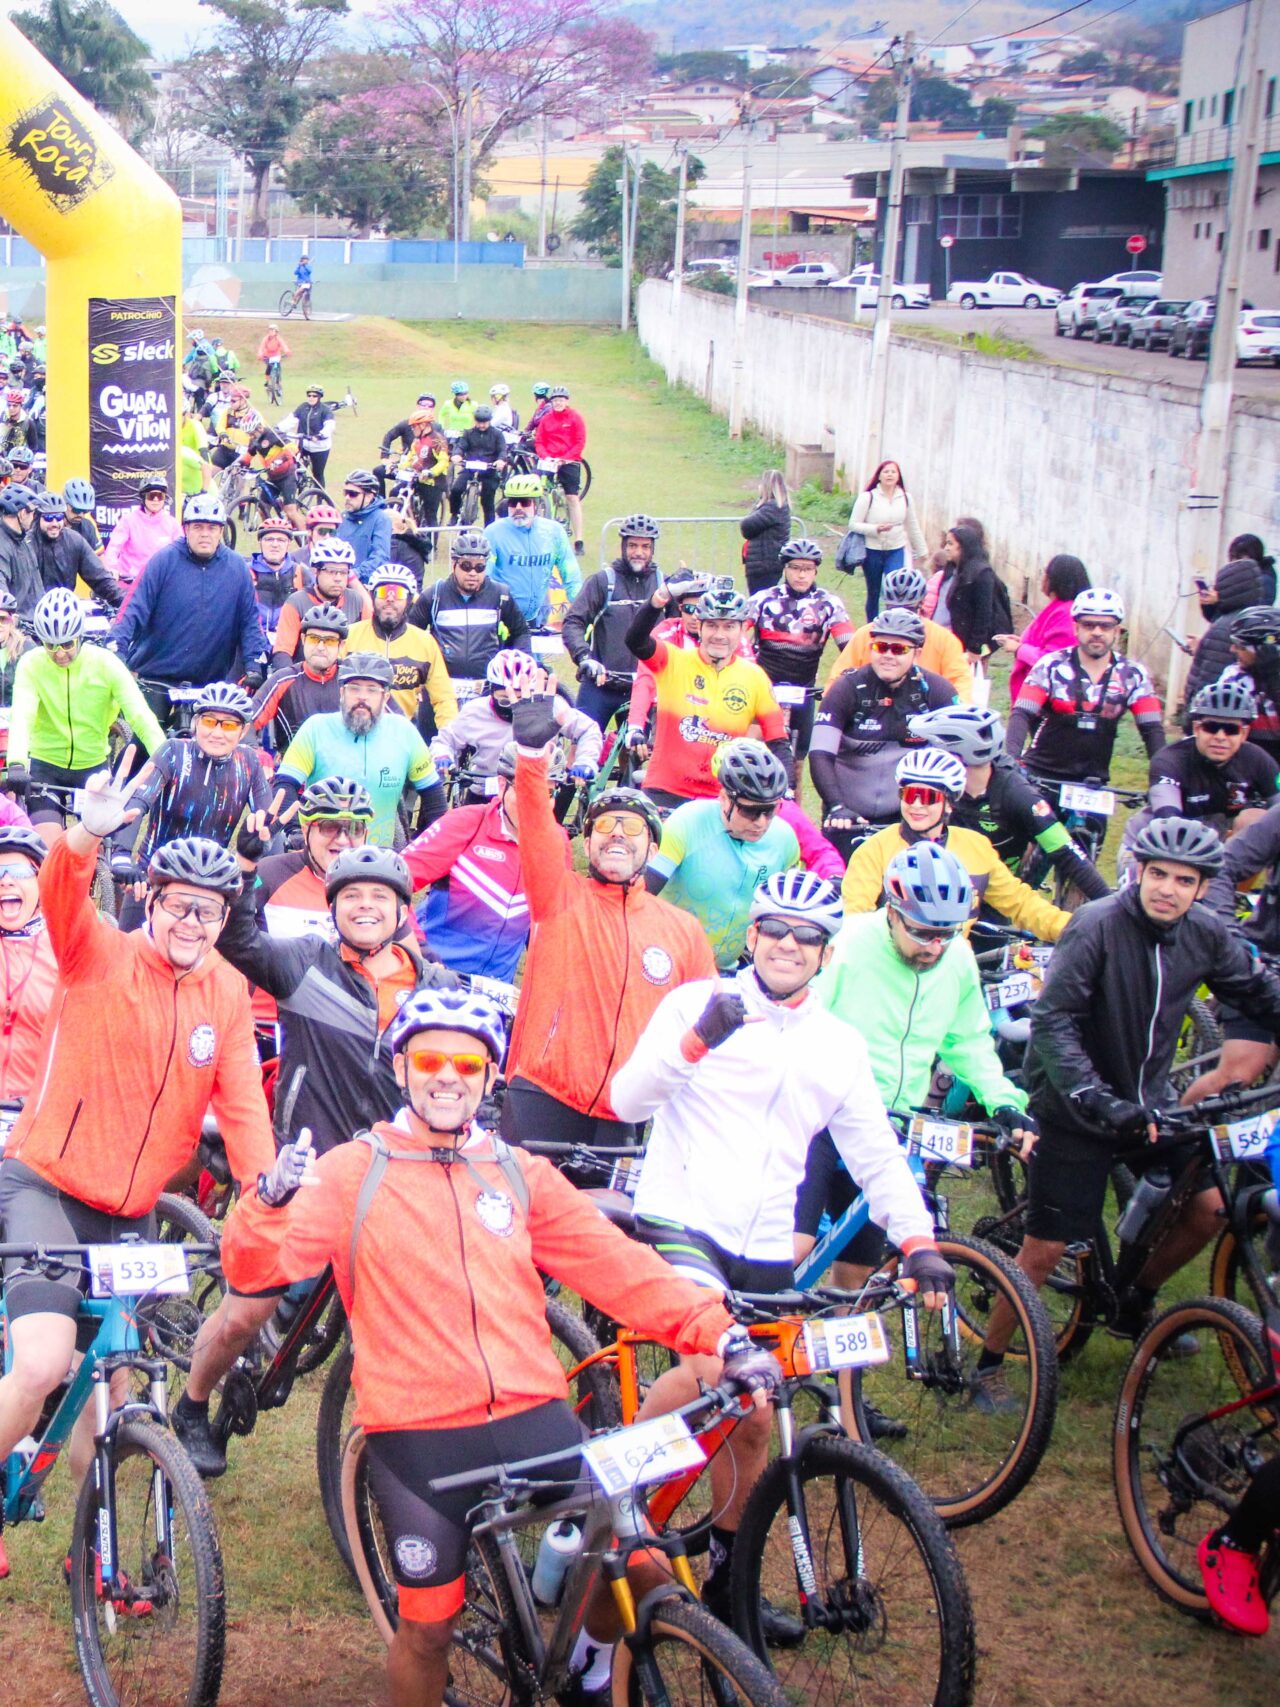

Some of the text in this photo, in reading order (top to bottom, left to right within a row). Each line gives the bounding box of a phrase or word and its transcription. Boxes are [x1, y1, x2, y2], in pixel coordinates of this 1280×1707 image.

[123, 339, 176, 362] sleck
[100, 385, 168, 417] GUARA
[508, 552, 551, 567] FURIA
[927, 1134, 954, 1152] 418
[120, 1261, 158, 1280] 533
[835, 1331, 868, 1353] 589
[791, 1534, 817, 1596] ROCKSHOX
